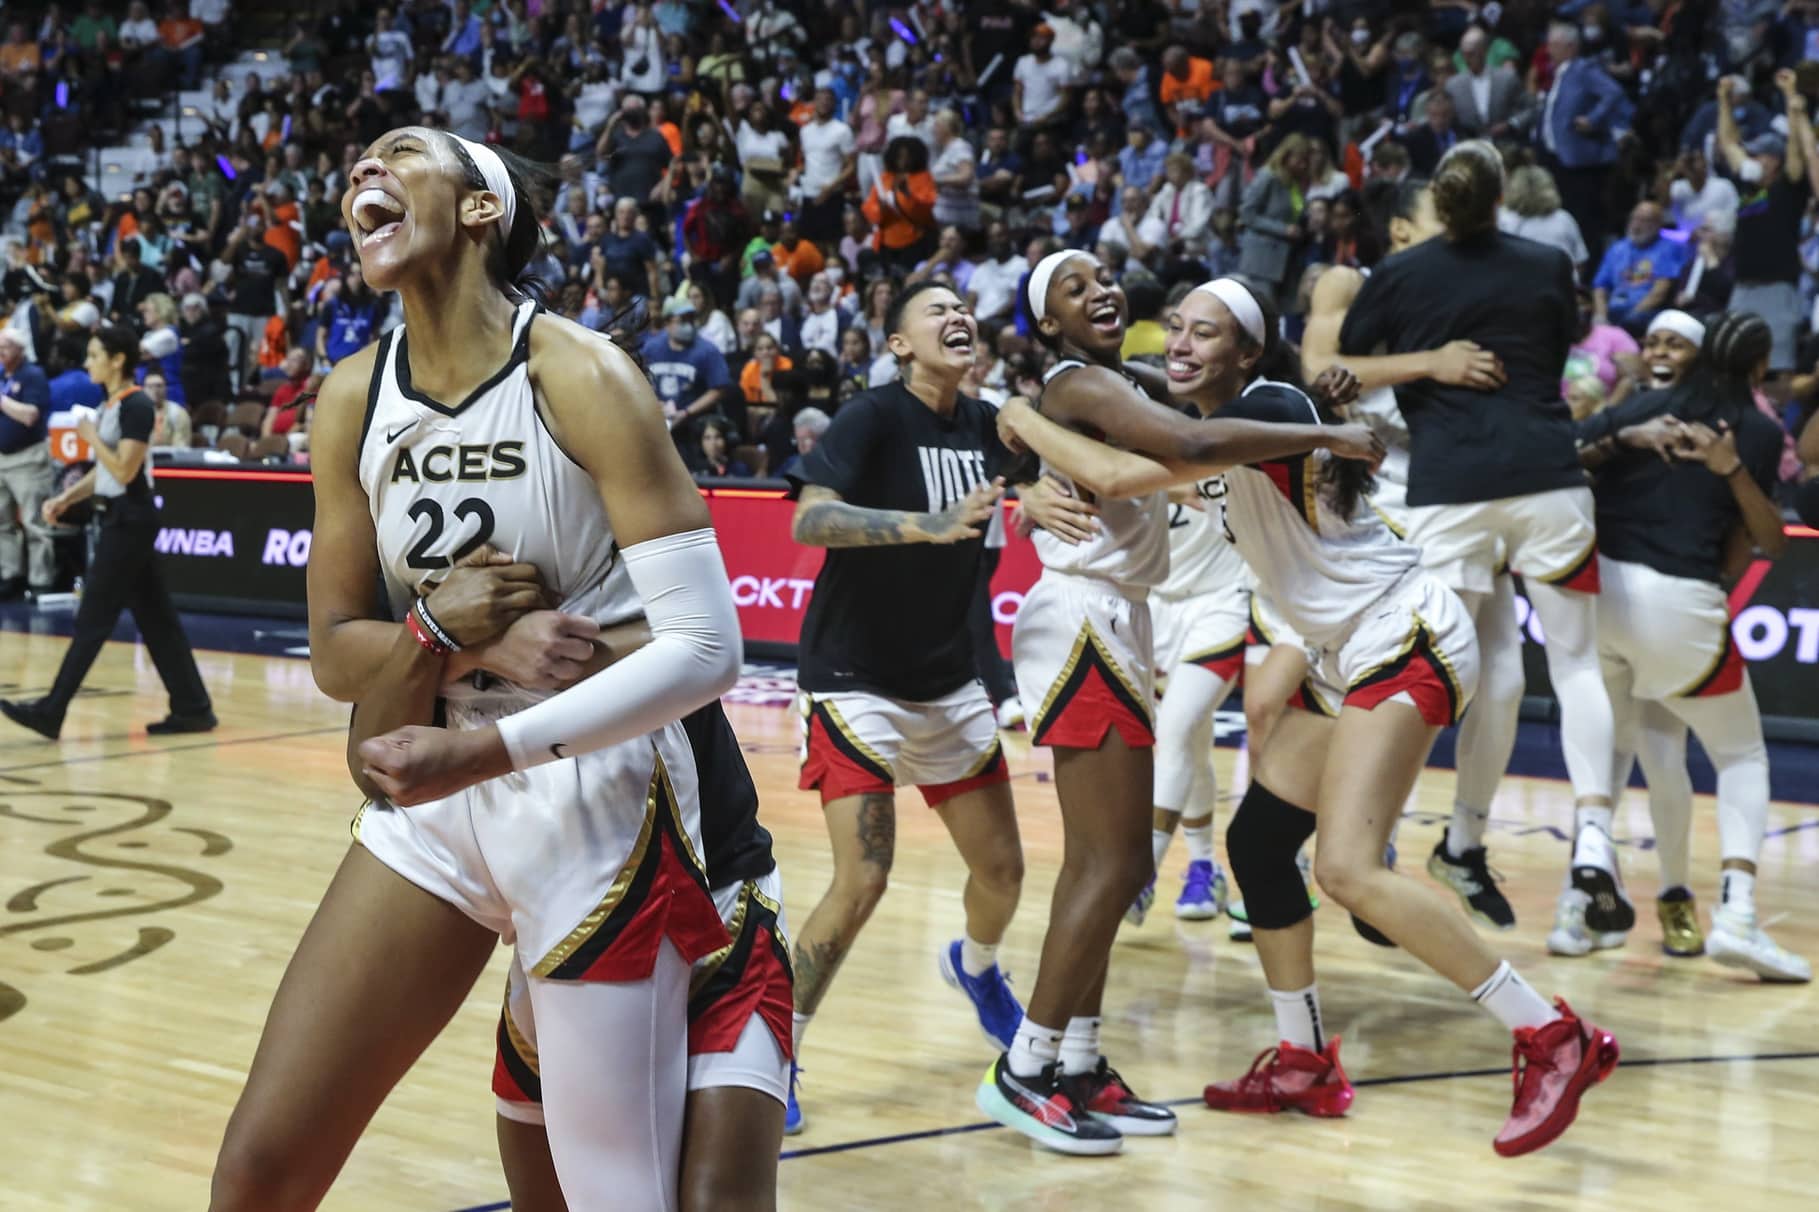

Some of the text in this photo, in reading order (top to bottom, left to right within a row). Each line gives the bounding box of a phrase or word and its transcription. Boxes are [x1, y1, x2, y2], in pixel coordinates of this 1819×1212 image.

[391, 441, 527, 483] ACES
[918, 446, 991, 513] VOTE
[154, 527, 234, 557] WNBA
[406, 497, 495, 569] 22
